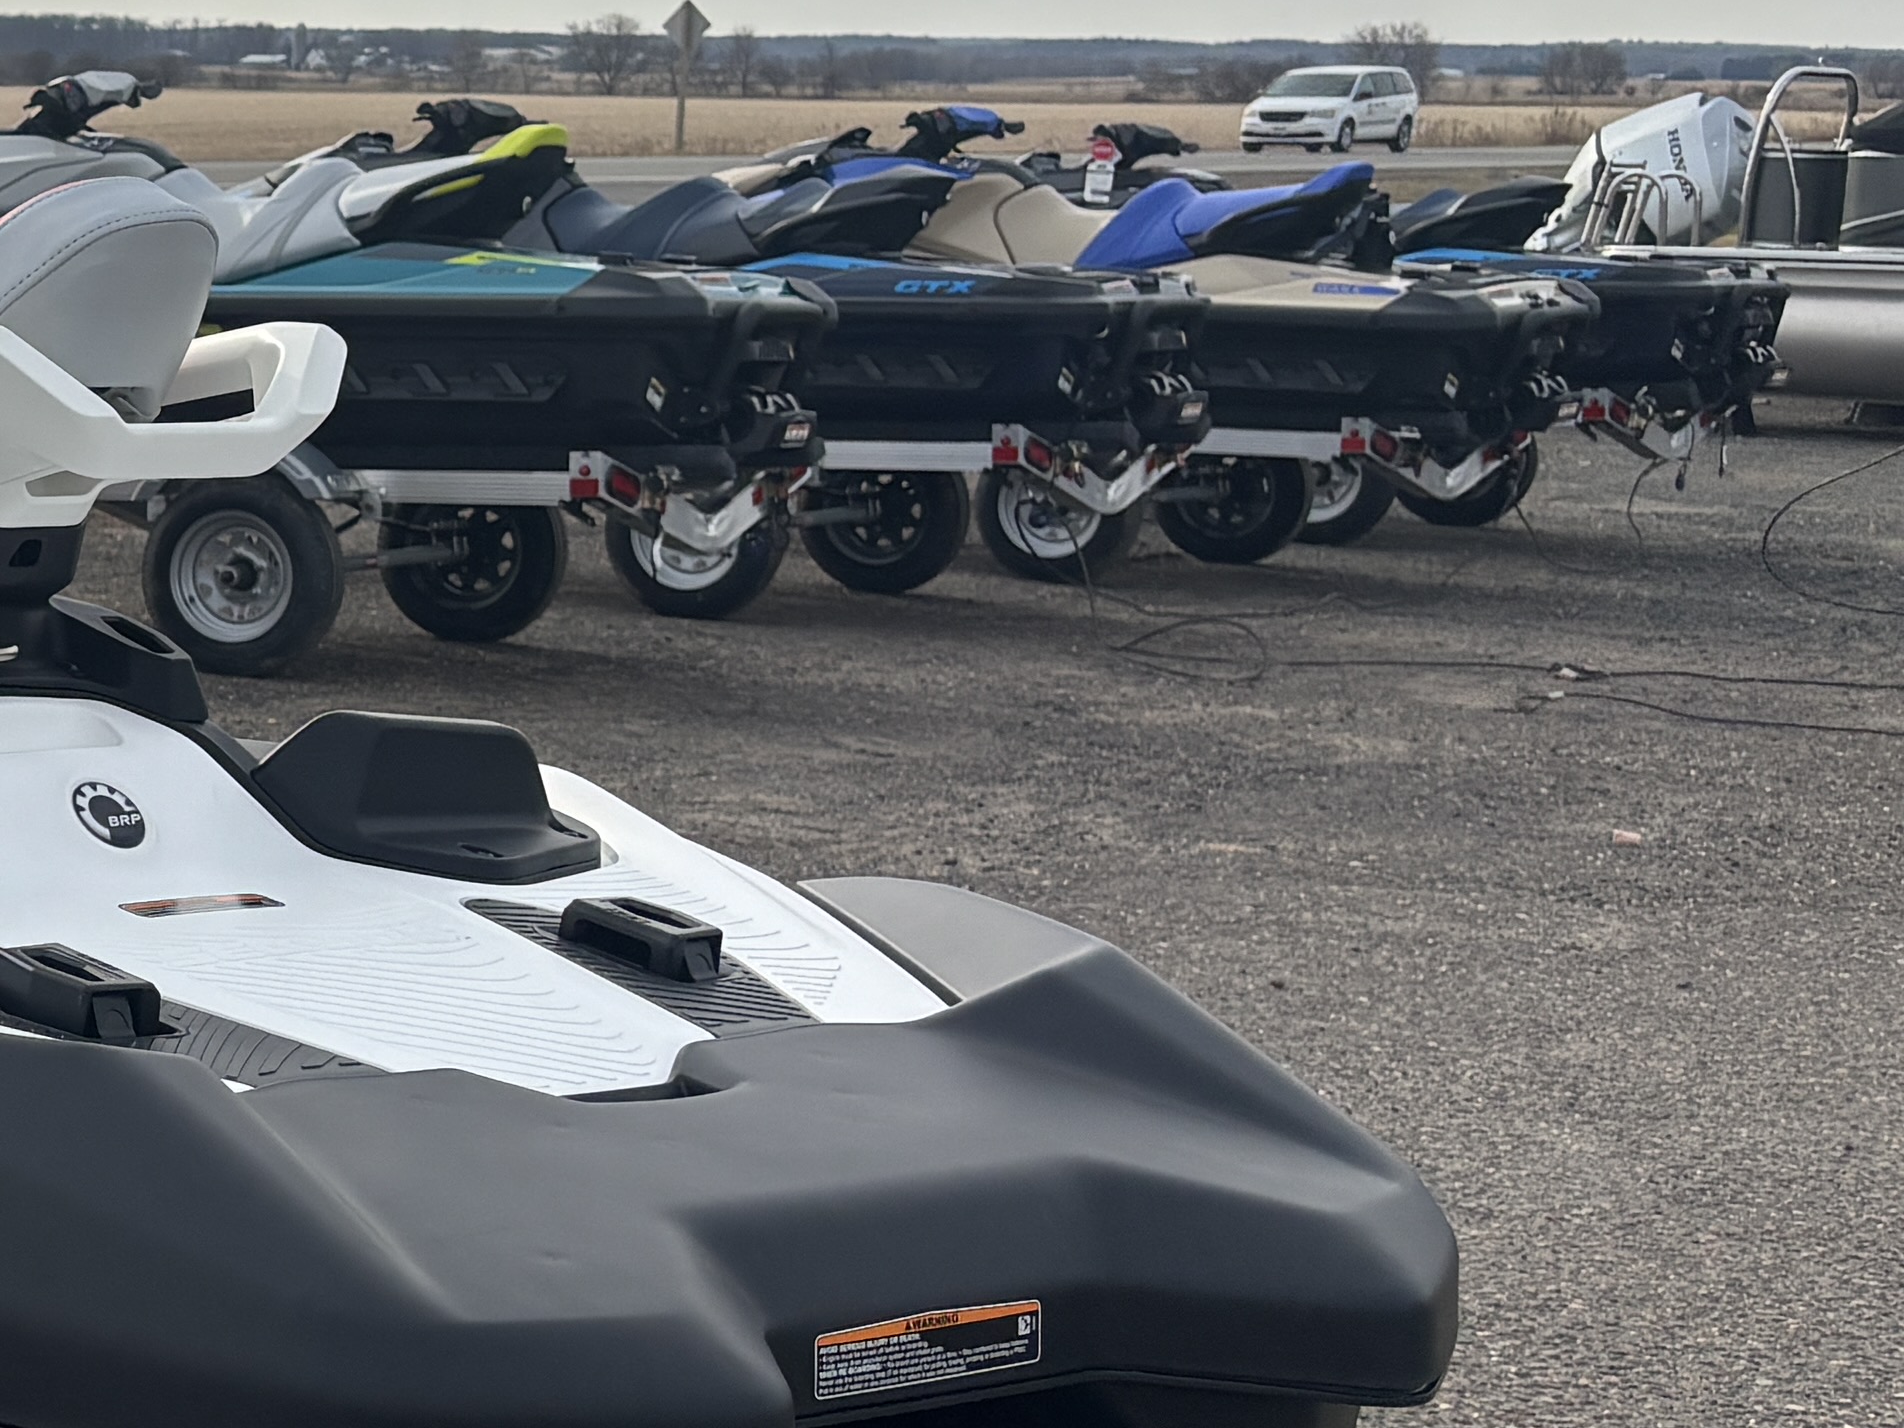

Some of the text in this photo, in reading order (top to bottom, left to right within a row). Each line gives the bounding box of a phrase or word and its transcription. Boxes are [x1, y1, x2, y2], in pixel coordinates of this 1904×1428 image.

[894, 280, 976, 294] GTX
[107, 813, 141, 828] BRP
[911, 1313, 959, 1330] WARNING
